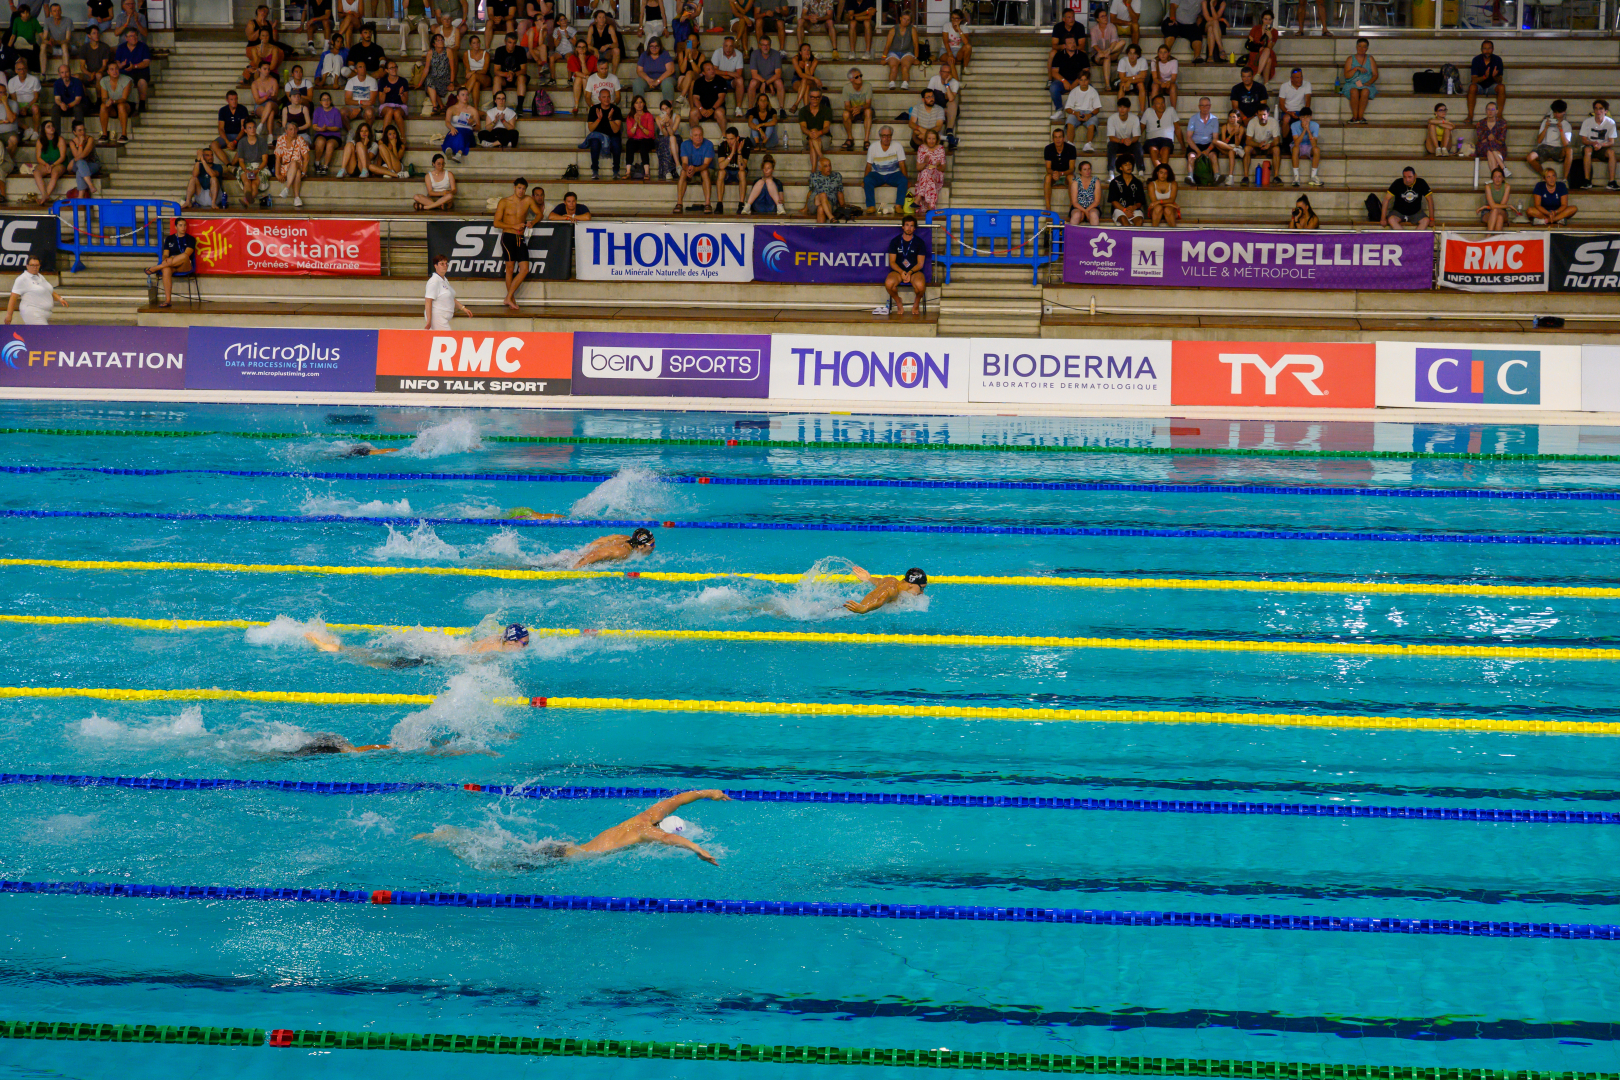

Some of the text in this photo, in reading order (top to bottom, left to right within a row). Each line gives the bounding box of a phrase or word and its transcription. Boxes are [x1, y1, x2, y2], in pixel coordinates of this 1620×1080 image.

[246, 225, 308, 239] La Région
[246, 239, 360, 258] Occitanie
[586, 228, 745, 268] THONON
[1181, 241, 1403, 267] MONTPELLIER
[1463, 244, 1525, 270] RMC
[247, 260, 289, 270] Pyrénées
[296, 260, 360, 270] Méditerranée
[795, 251, 890, 267] FFNATATI
[1137, 249, 1158, 266] M
[611, 268, 719, 278] Eau Minérale Naturelle des Alpes
[1181, 265, 1316, 279] VILLE & MÉTROPOLE
[1447, 274, 1542, 283] INFO TALK SPORT
[28, 351, 183, 369] FFNATATION
[224, 342, 340, 371] Microplus
[427, 336, 525, 373] RMC
[590, 349, 752, 373] beIN SPORTS
[241, 370, 320, 378] www.microplustiming.com
[791, 348, 950, 389] THONON
[983, 353, 1157, 379] BIODERMA
[1218, 353, 1325, 396] TYR
[400, 379, 548, 392] INFO TALK SPORT
[1428, 358, 1528, 395] CIC
[1061, 382, 1158, 391] DERMATOLOGIQUE
